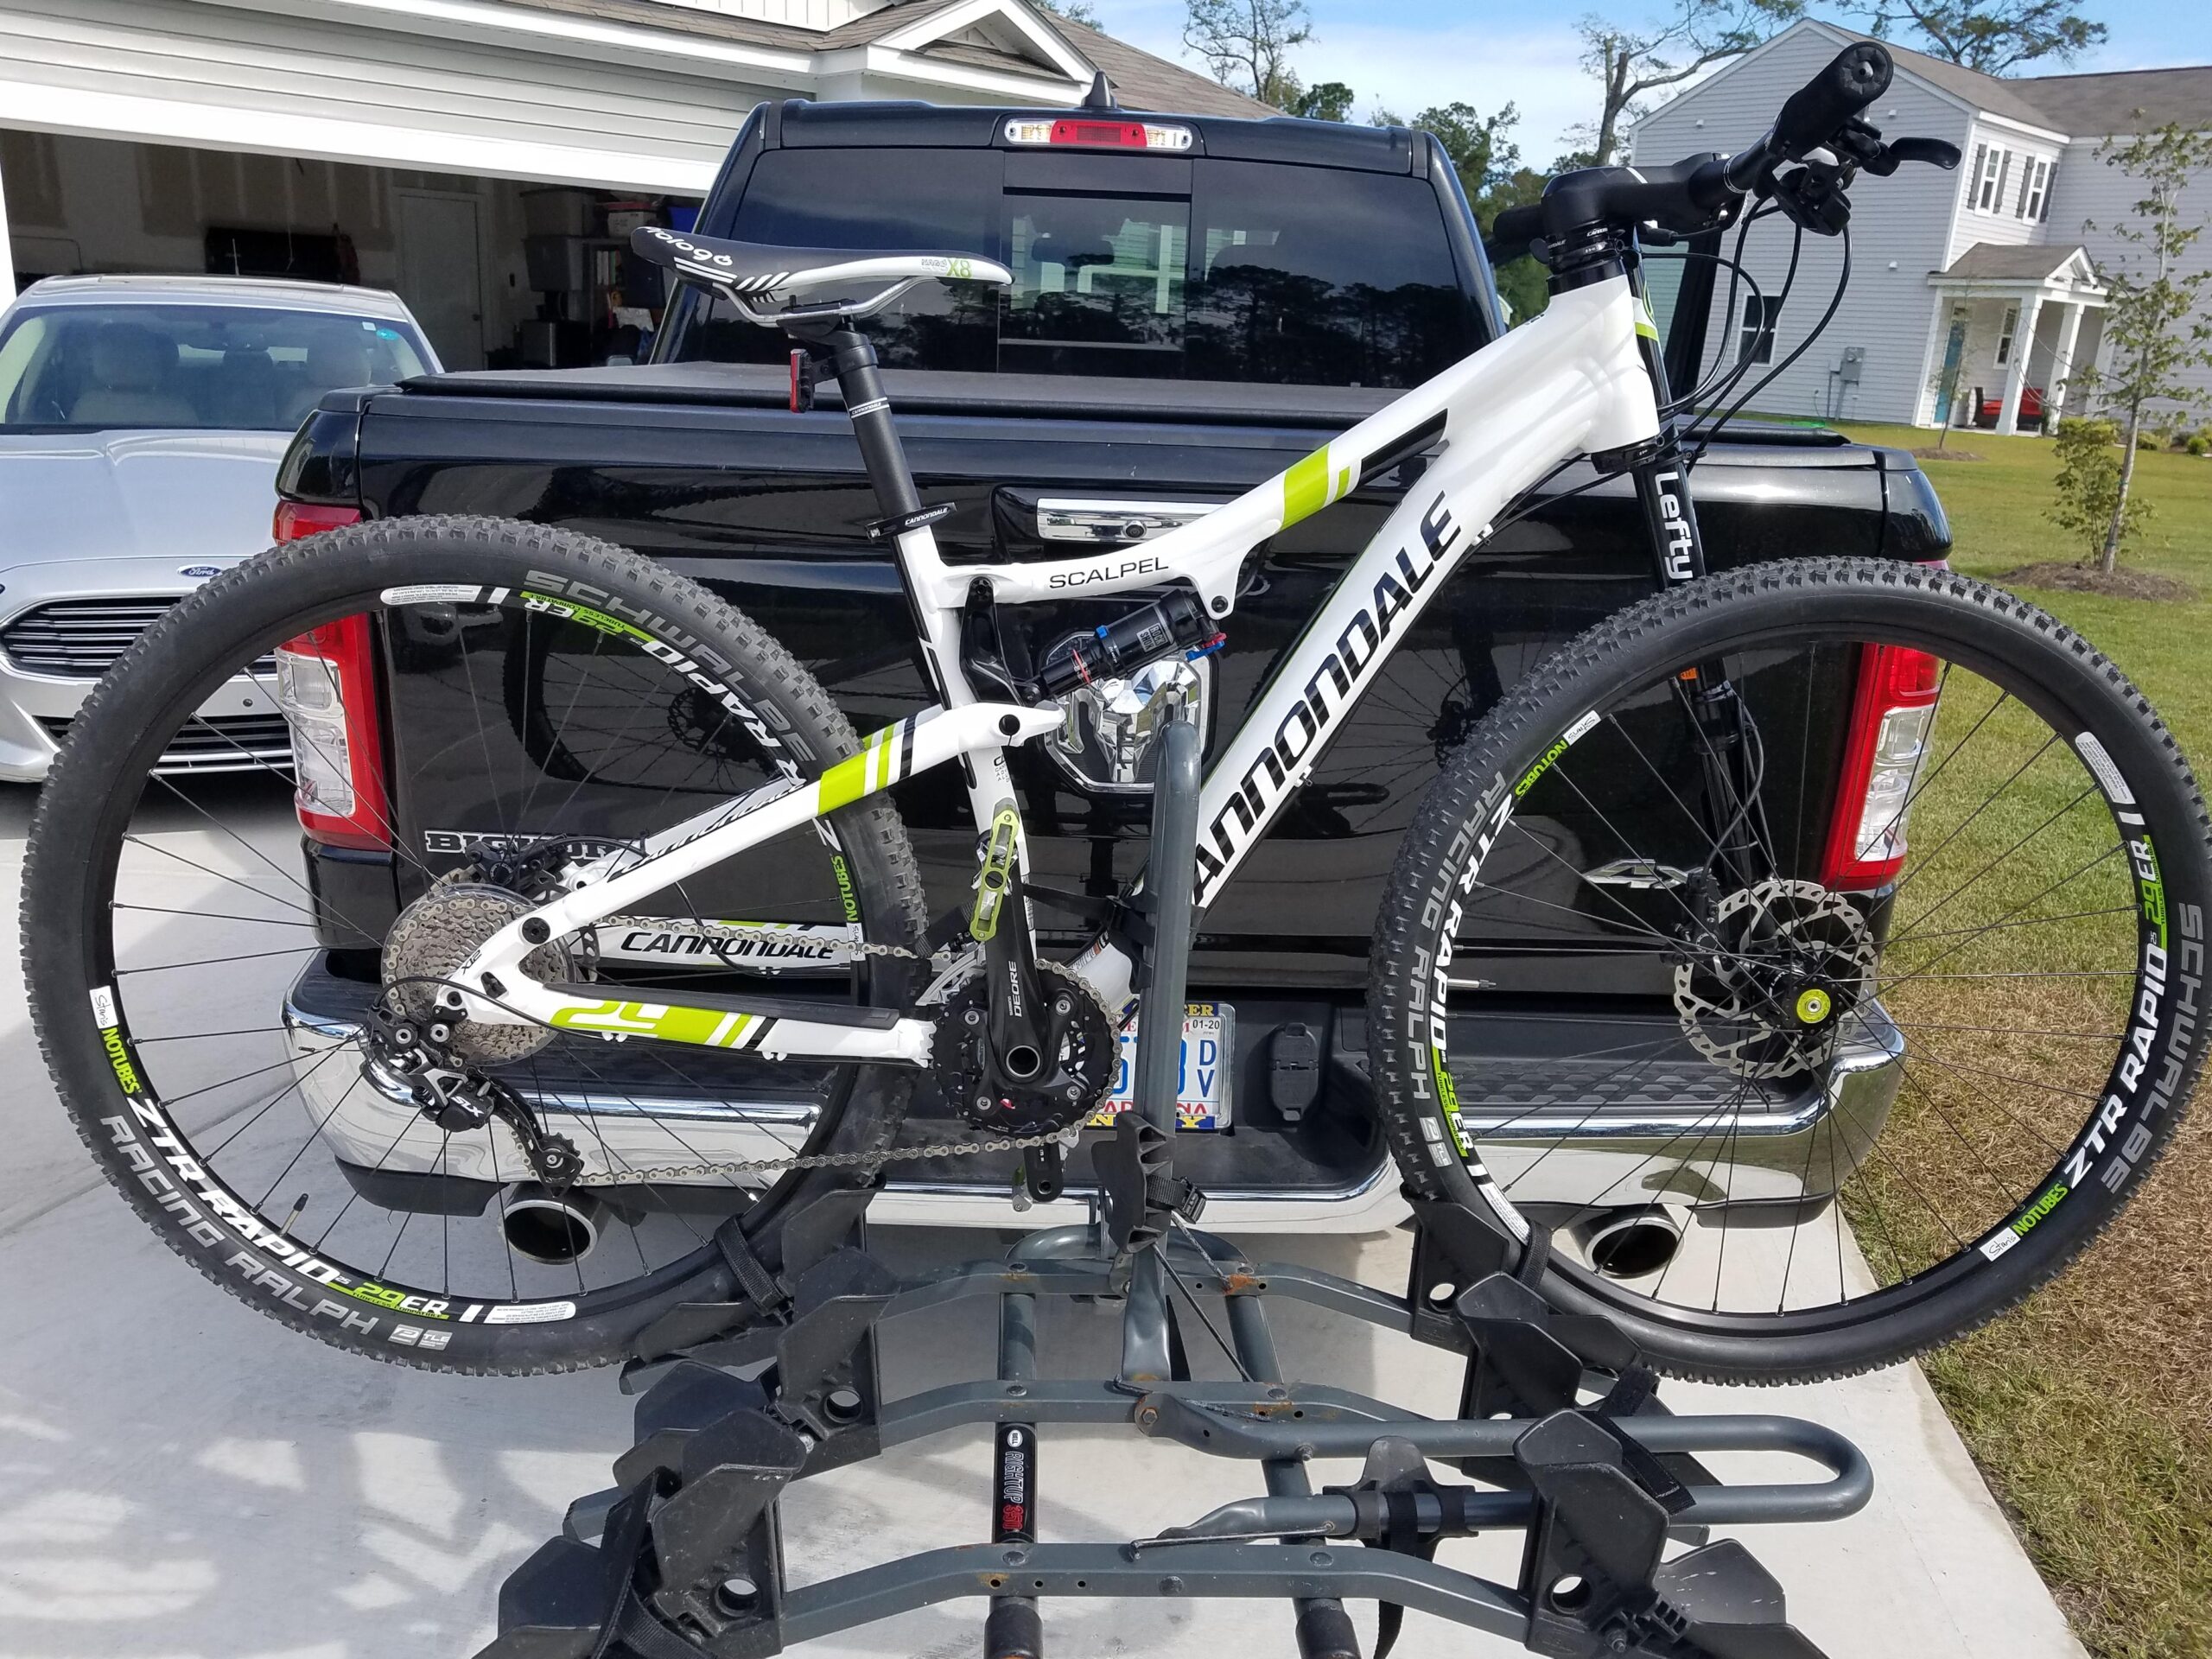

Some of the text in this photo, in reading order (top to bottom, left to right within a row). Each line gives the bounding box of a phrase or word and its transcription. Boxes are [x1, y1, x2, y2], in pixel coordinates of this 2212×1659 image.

[947, 258, 972, 277] X8
[905, 507, 948, 525] CANNONDALE
[1655, 471, 1694, 580] Lefty
[1049, 557, 1169, 588] SCALPEL
[523, 569, 817, 761] SCHWALBE
[641, 639, 783, 748] RAPID
[1192, 490, 1462, 906] ANNONDALE
[1515, 740, 1568, 798] NOTUBES
[1459, 793, 1515, 895] ZTR
[2131, 839, 2162, 925] 29ER
[831, 855, 859, 922] NOTUBES
[621, 931, 835, 959] CANNONDALE
[1408, 771, 1507, 1100] RACING RALPH
[1430, 899, 1464, 1051] RAPID
[1008, 961, 1022, 1017] DEORE
[1192, 1019, 1220, 1030] 01-20
[2120, 943, 2168, 1094] RAPID
[1197, 1069, 1215, 1098] V
[1199, 1039, 1217, 1066] D
[2101, 902, 2204, 1194] SCHWALBE
[451, 1095, 486, 1118] SLX
[2064, 1094, 2127, 1189] ZTR
[101, 1027, 141, 1094] NOTUBES
[126, 1097, 206, 1182] ZTR
[197, 1189, 341, 1284] RAPID
[355, 1282, 449, 1316] 29ER
[2012, 1182, 2069, 1236] NOTUBES
[100, 1115, 380, 1336] RACING RALPH
[1002, 1451, 1024, 1530] RIGHTUP 350
